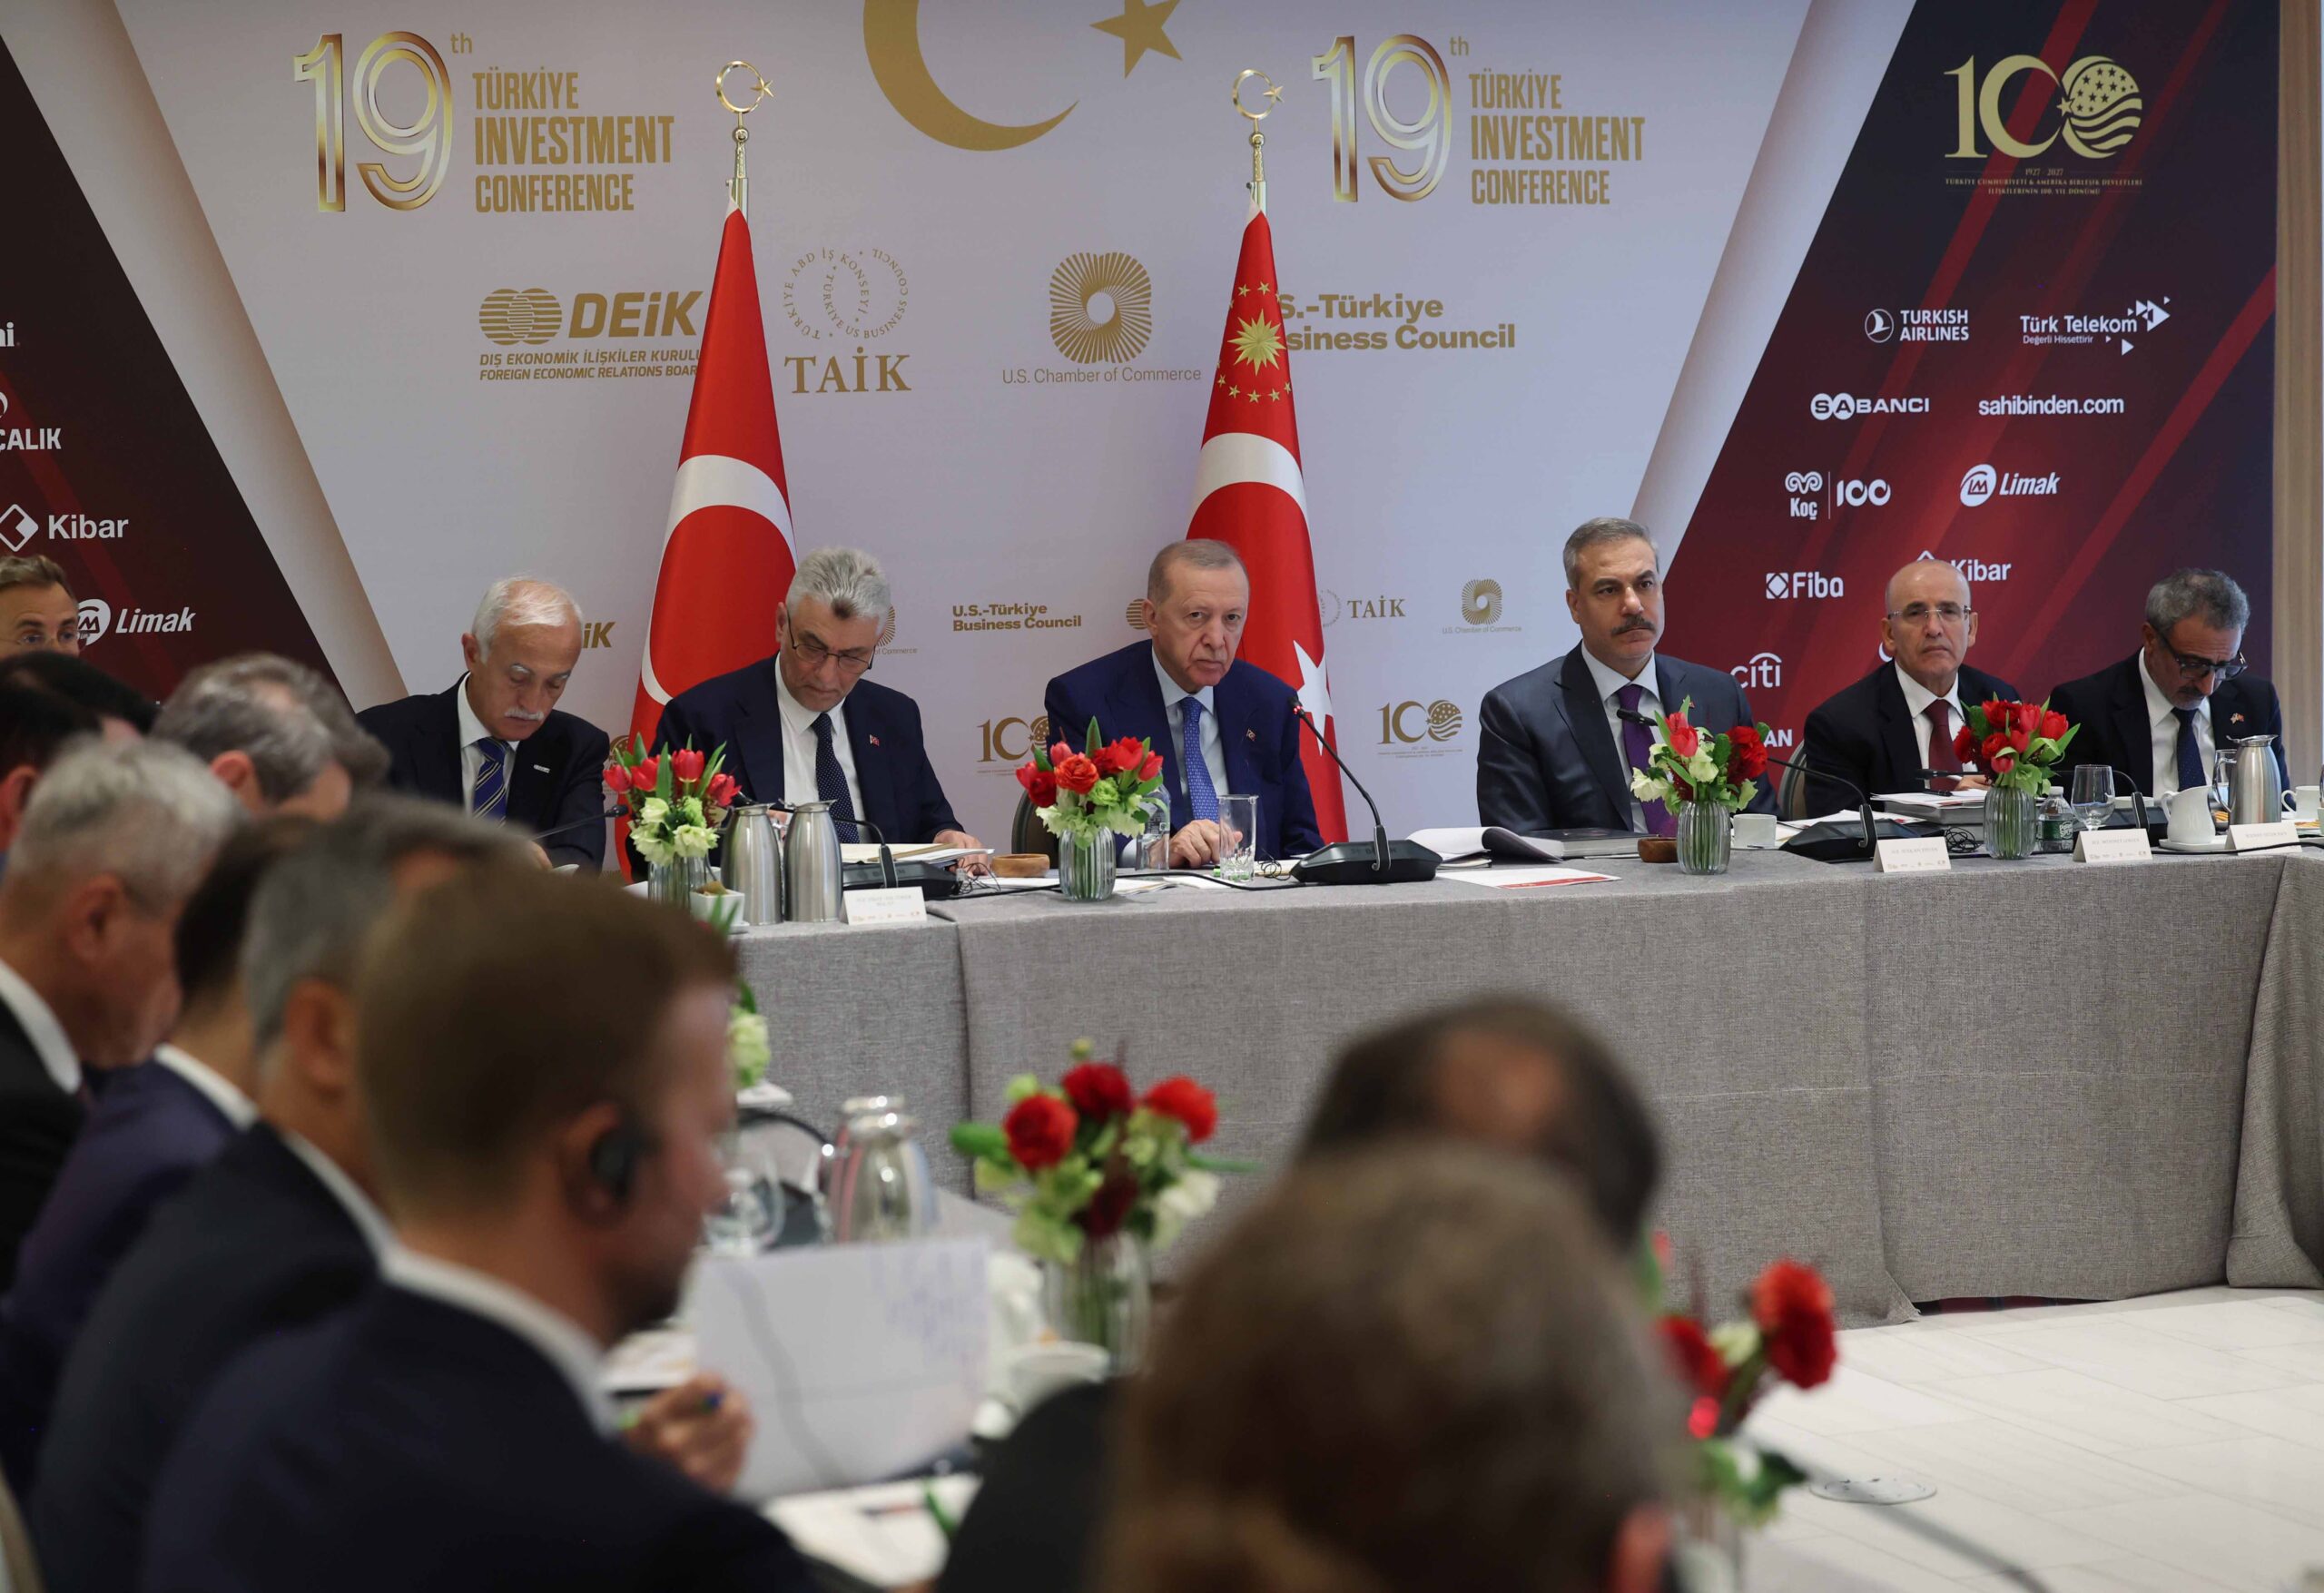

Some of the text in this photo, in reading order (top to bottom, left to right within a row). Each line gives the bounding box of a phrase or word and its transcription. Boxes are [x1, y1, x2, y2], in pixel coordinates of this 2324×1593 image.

[472, 66, 579, 110] TÜRKİYE
[1469, 68, 1561, 110] TÜRKİYE
[474, 115, 675, 165] INVESTMENT
[1471, 115, 1645, 162] INVESTMENT
[475, 173, 635, 213] CONFERENCE
[1472, 169, 1610, 205] CONFERENCE
[792, 252, 816, 277] ABD
[872, 248, 909, 296] COUNCIL
[863, 300, 908, 339] BUSINESS
[1279, 293, 1443, 323] S.-Türkiye
[1900, 309, 1969, 325] TURKISH
[845, 327, 860, 338] US
[1286, 323, 1515, 350] siness Council
[1900, 325, 1969, 342] AIRLINES
[2019, 315, 2137, 333] Türk Telekom
[2023, 335, 2052, 345] Değerli
[479, 353, 502, 369] DIŞ
[507, 349, 579, 365] EKONOMİK
[583, 349, 646, 367] İLİŞKİLER
[784, 346, 912, 394] TAİK
[479, 365, 698, 380] FOREIGN ECONOMIC RELATIONS BOAR
[1002, 367, 1201, 384] U.S. Chamber of Commerce
[1812, 394, 1930, 418] SABANCI
[1978, 394, 2124, 416] sahibinden.com
[1837, 478, 1891, 507] 100
[1999, 472, 2061, 495] Limak
[1790, 497, 1817, 520] Koç
[48, 514, 129, 539] Kibar
[1793, 571, 1844, 598] Fiba
[952, 603, 1048, 617] U.S.-Türkiye
[1347, 595, 1406, 618] TAİK
[115, 606, 196, 634] Limak
[953, 615, 1082, 632] Business Council
[582, 622, 615, 648] iK
[1764, 729, 1792, 747] AN
